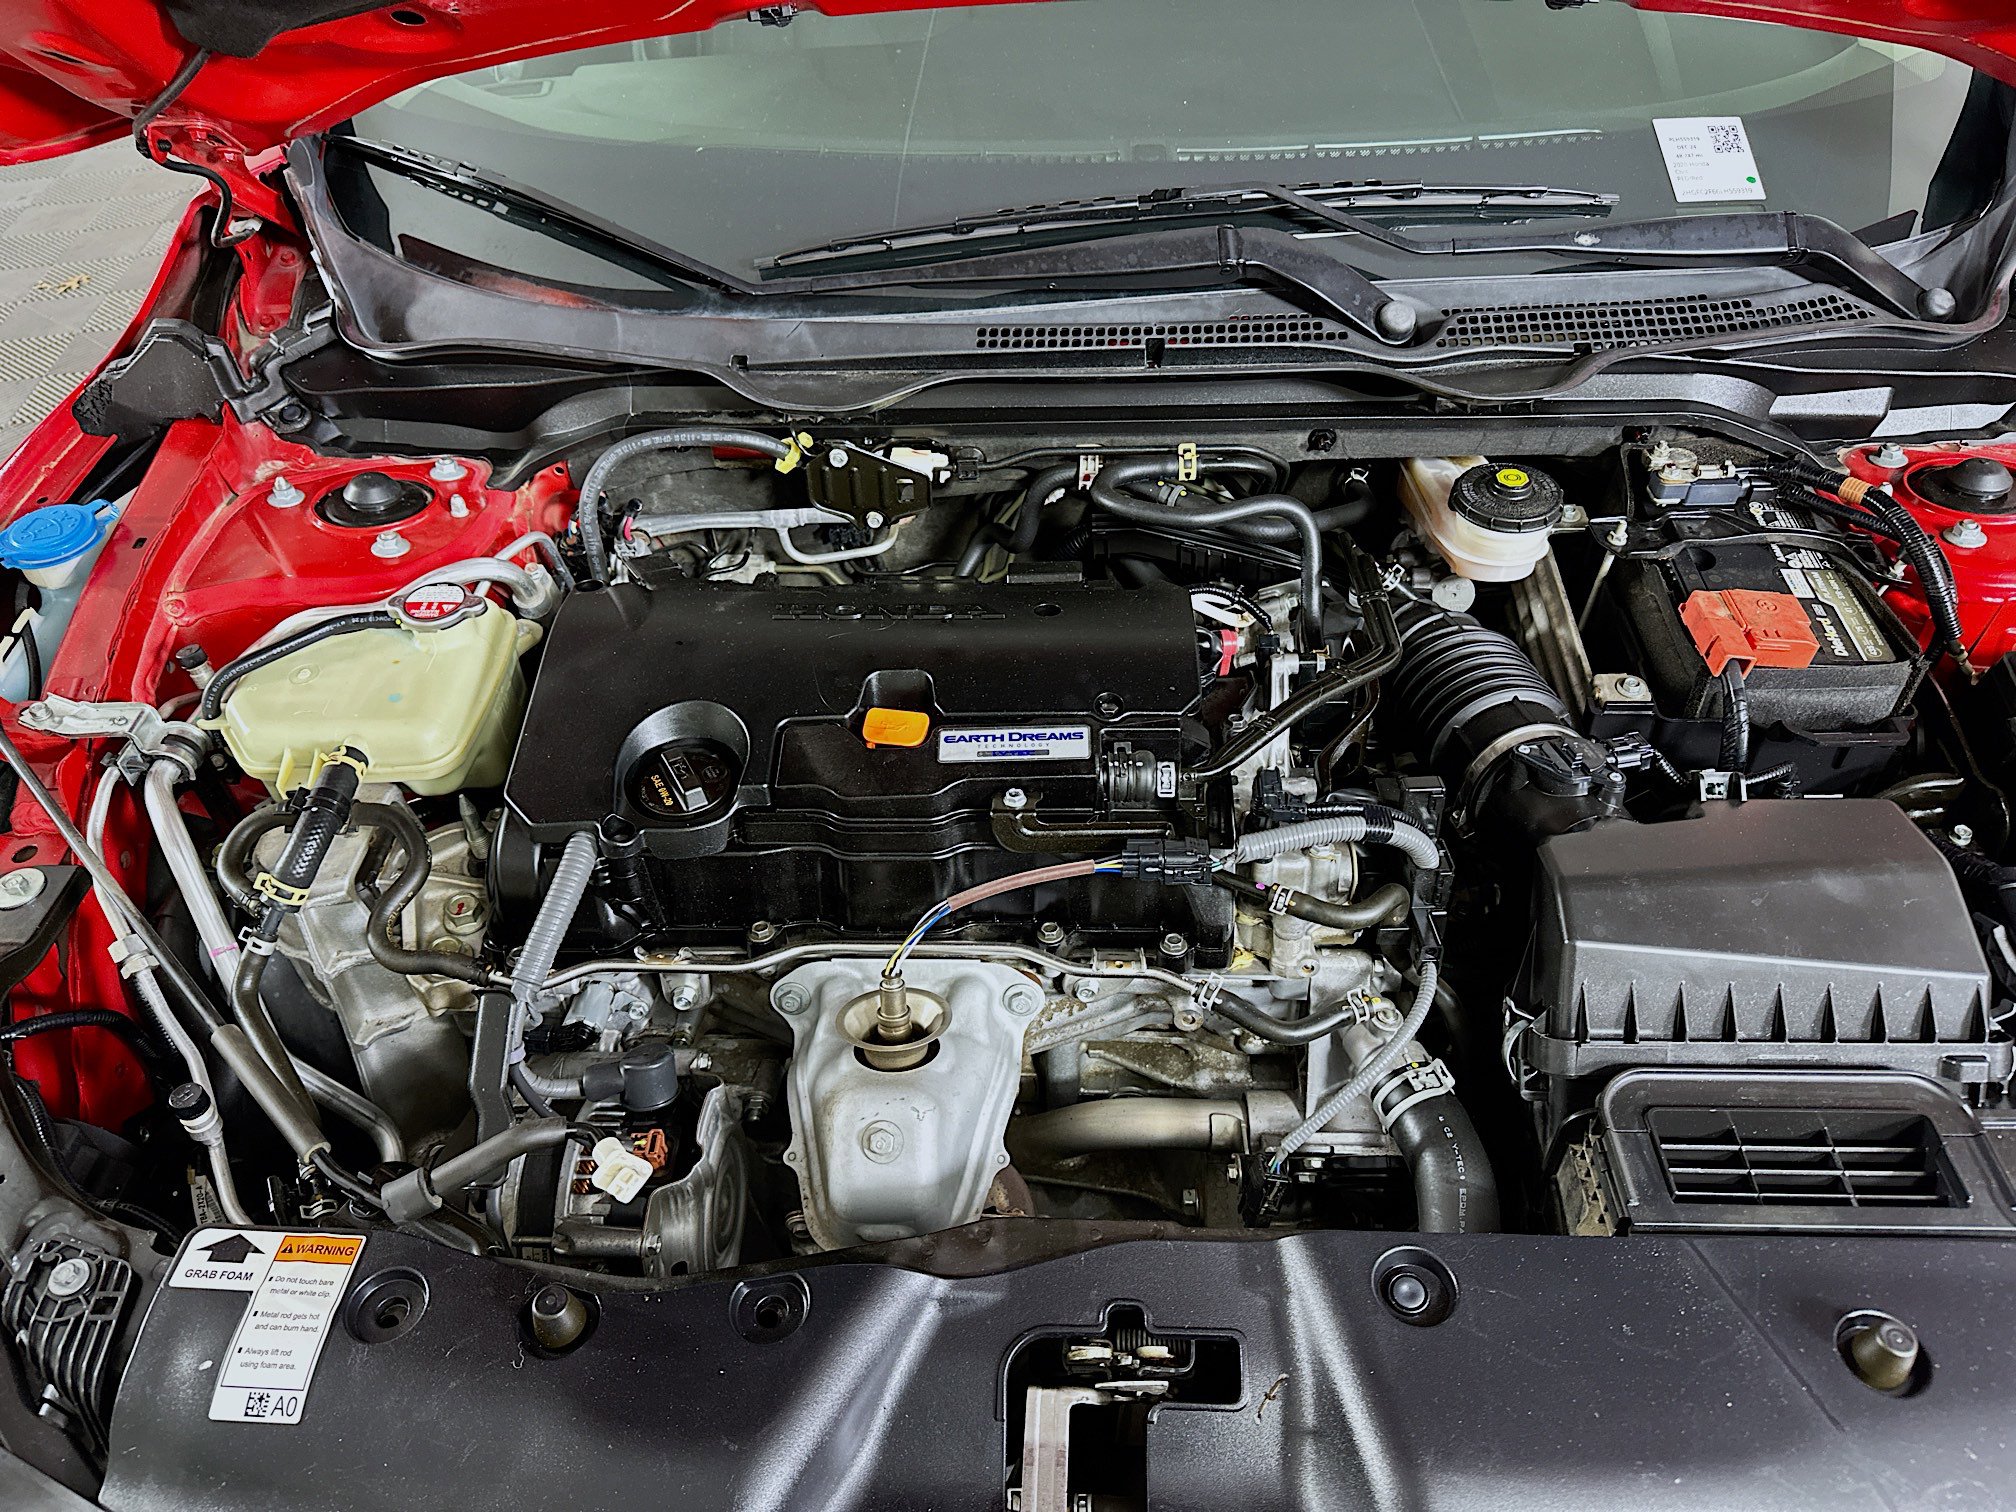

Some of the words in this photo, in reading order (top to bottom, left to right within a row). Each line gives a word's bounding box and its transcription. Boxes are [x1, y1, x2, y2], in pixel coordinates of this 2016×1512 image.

[1816, 617, 1849, 656] DieHard
[944, 734, 1004, 744] EARTH
[1008, 732, 1084, 742] DREAMS
[650, 774, 664, 788] SAE
[296, 1244, 354, 1256] WARNING
[184, 1269, 217, 1279] GRAB
[219, 1270, 254, 1281] FOAM
[286, 1276, 298, 1284] not
[298, 1277, 317, 1286] touch
[318, 1278, 334, 1286] bare
[270, 1288, 289, 1296] metal
[317, 1290, 331, 1298] clip.
[260, 1311, 279, 1320] Metal
[280, 1312, 292, 1320] rod
[292, 1313, 308, 1322] gets
[254, 1322, 268, 1330] and
[300, 1324, 319, 1333] hand.
[244, 1347, 270, 1357] Always
[270, 1348, 280, 1356] lift
[280, 1349, 293, 1357] rod
[240, 1360, 259, 1370] using
[260, 1361, 278, 1370] foam
[278, 1362, 296, 1370] area.
